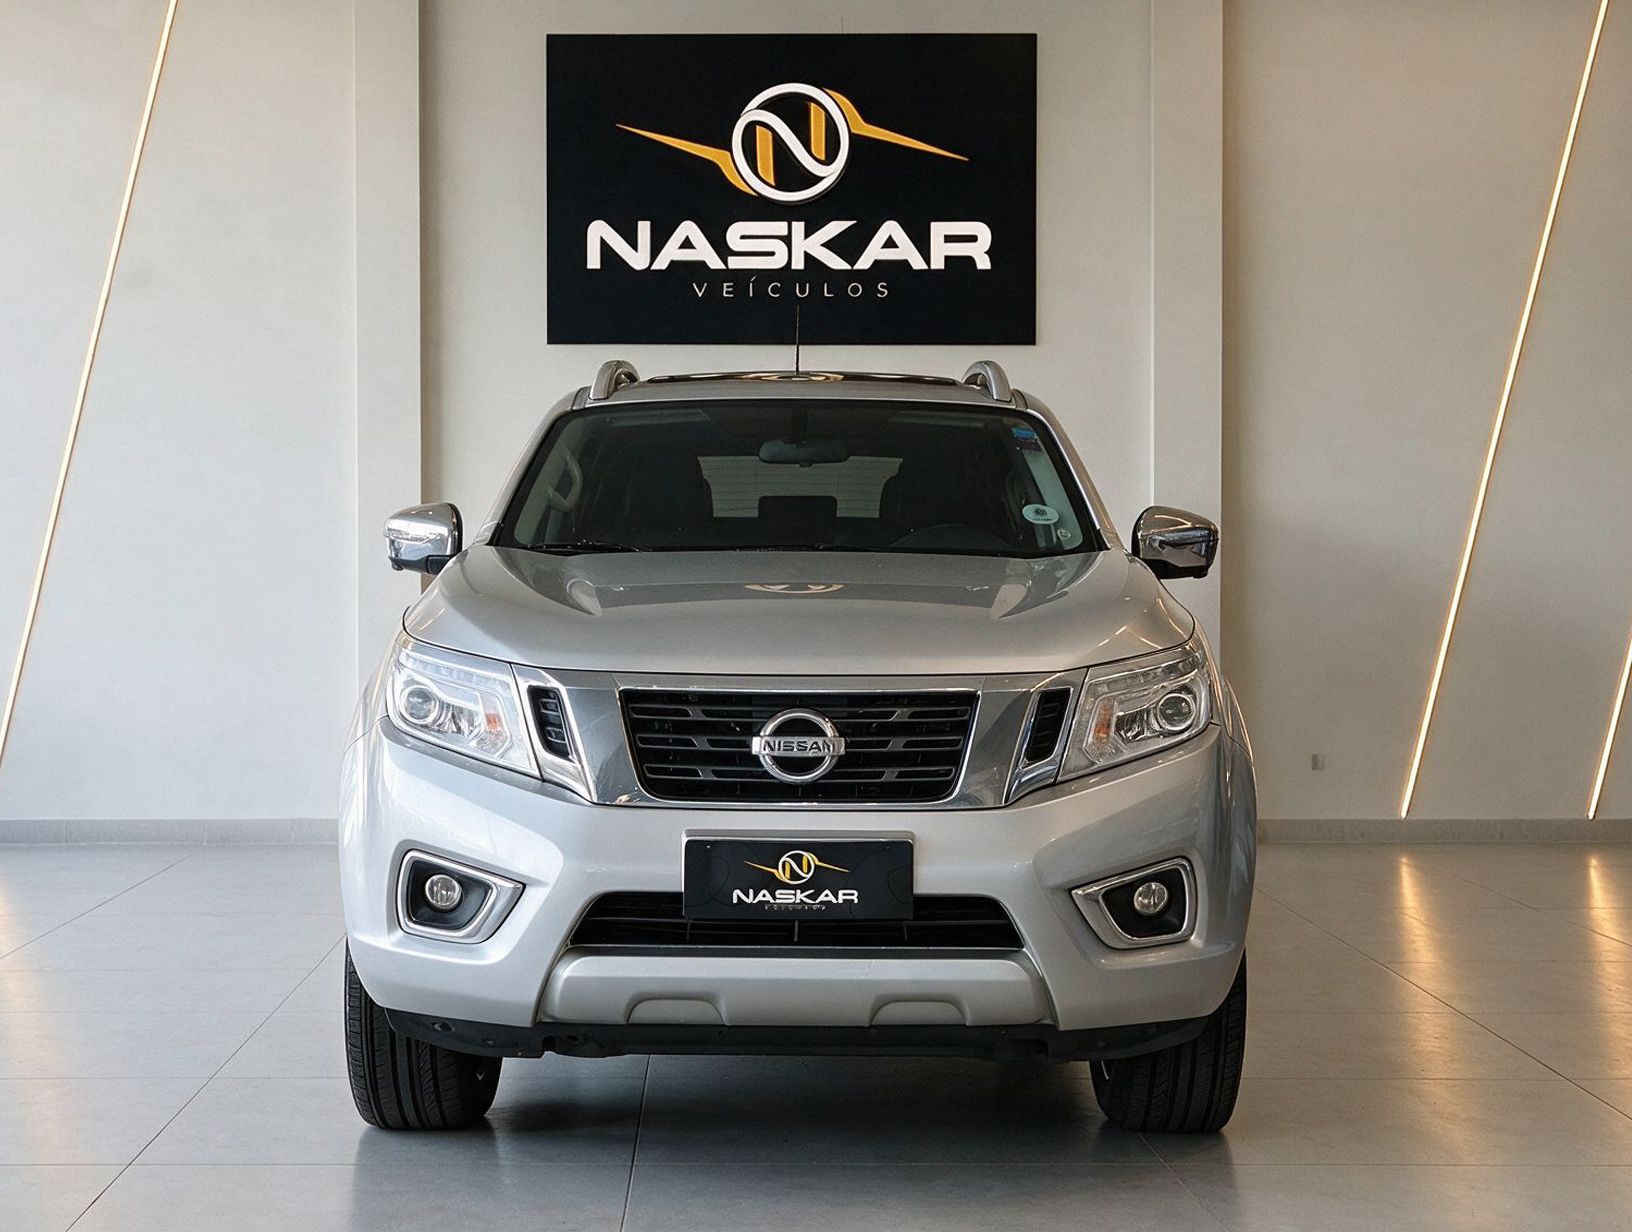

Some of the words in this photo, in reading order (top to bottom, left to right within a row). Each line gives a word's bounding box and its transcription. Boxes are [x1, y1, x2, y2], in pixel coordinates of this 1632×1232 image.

[586, 219, 992, 270] NASKAR
[692, 276, 889, 298] VEÍCULOS
[763, 739, 835, 752] NISSAN
[732, 888, 858, 904] NASKAR
